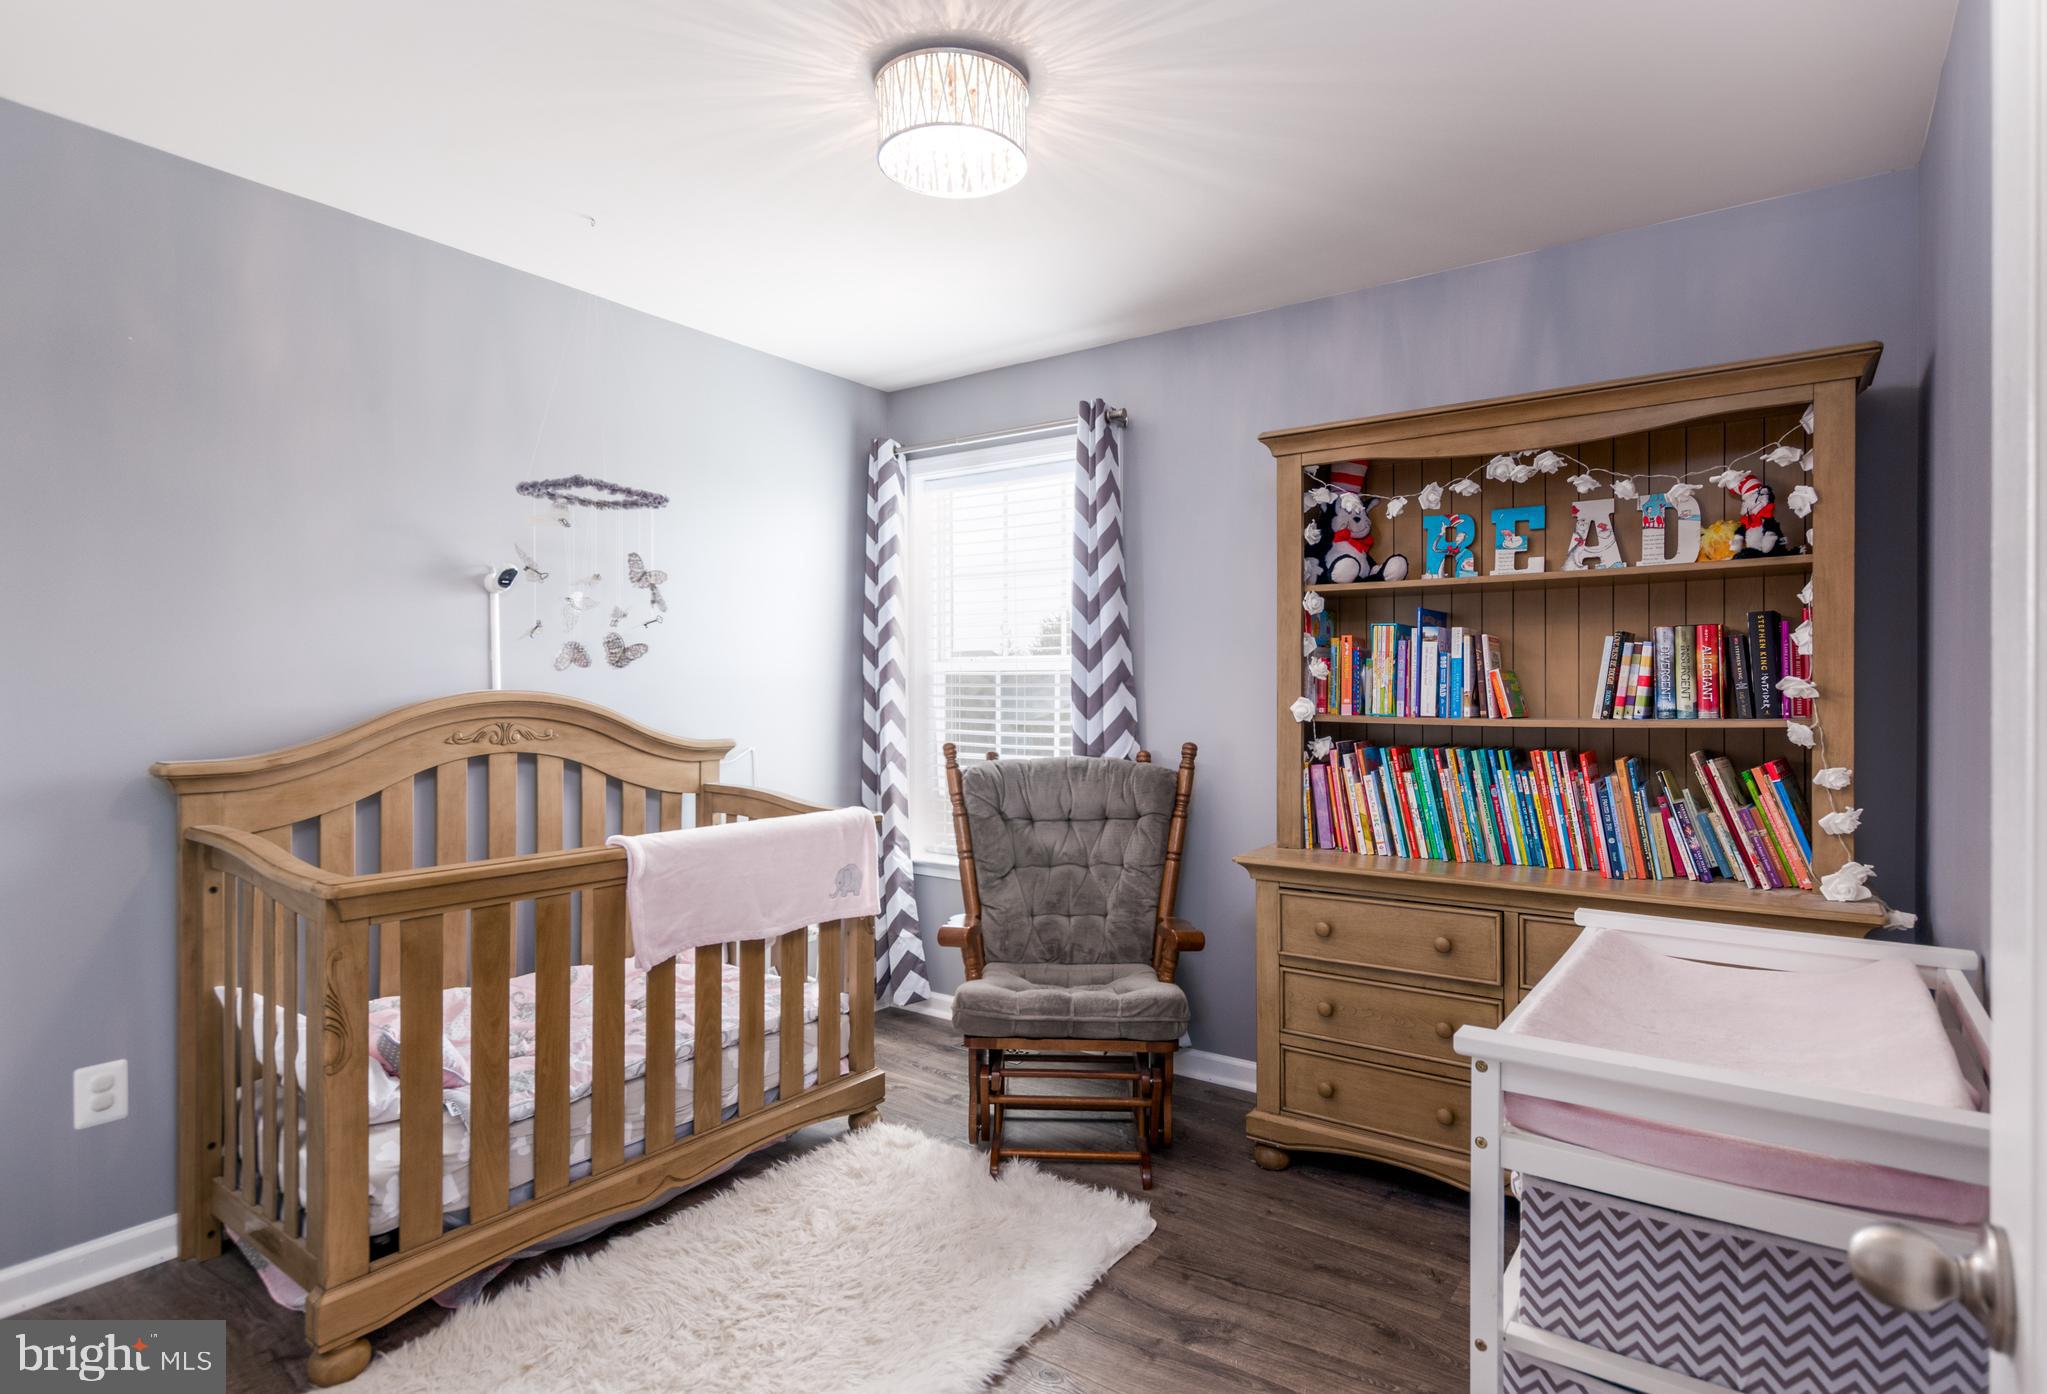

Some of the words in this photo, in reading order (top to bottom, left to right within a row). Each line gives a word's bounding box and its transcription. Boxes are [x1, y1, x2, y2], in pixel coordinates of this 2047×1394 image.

[1421, 493, 1701, 579] READ
[1758, 615, 1766, 649] STEPHEN
[1661, 646, 1671, 702] DIVERGENT
[1680, 645, 1691, 701] INSURGENT
[1702, 646, 1712, 701] ALLEGIANT
[1760, 651, 1768, 671] KING
[1761, 676, 1771, 710] OUTSIDER
